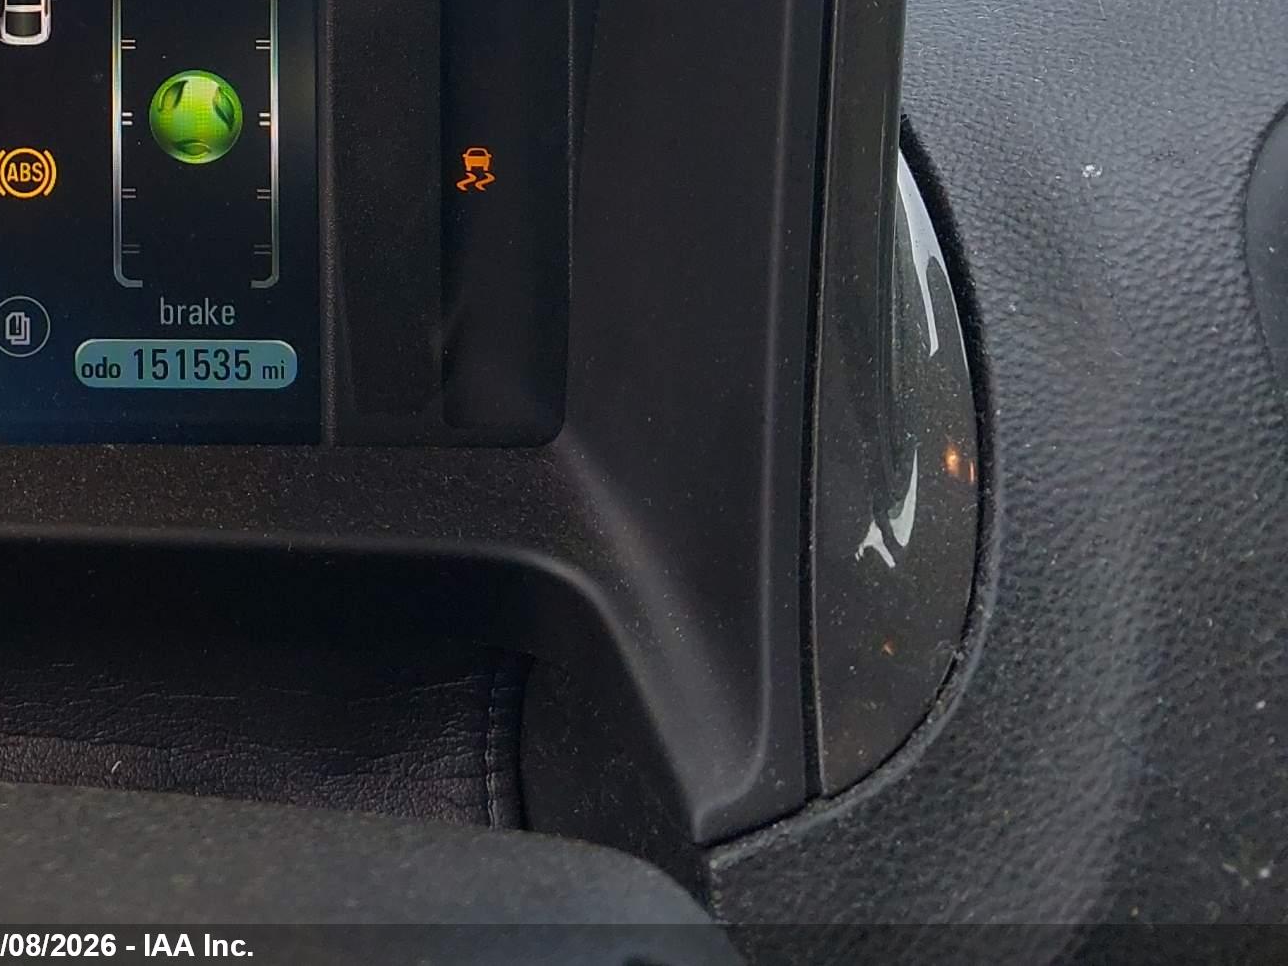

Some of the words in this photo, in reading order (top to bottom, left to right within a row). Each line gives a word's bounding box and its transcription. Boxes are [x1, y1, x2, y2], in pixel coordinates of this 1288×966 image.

[6, 162, 44, 184] ABS
[160, 296, 236, 326] brake
[80, 355, 121, 381] odo
[133, 348, 252, 382] 151535
[261, 359, 286, 381] mi
